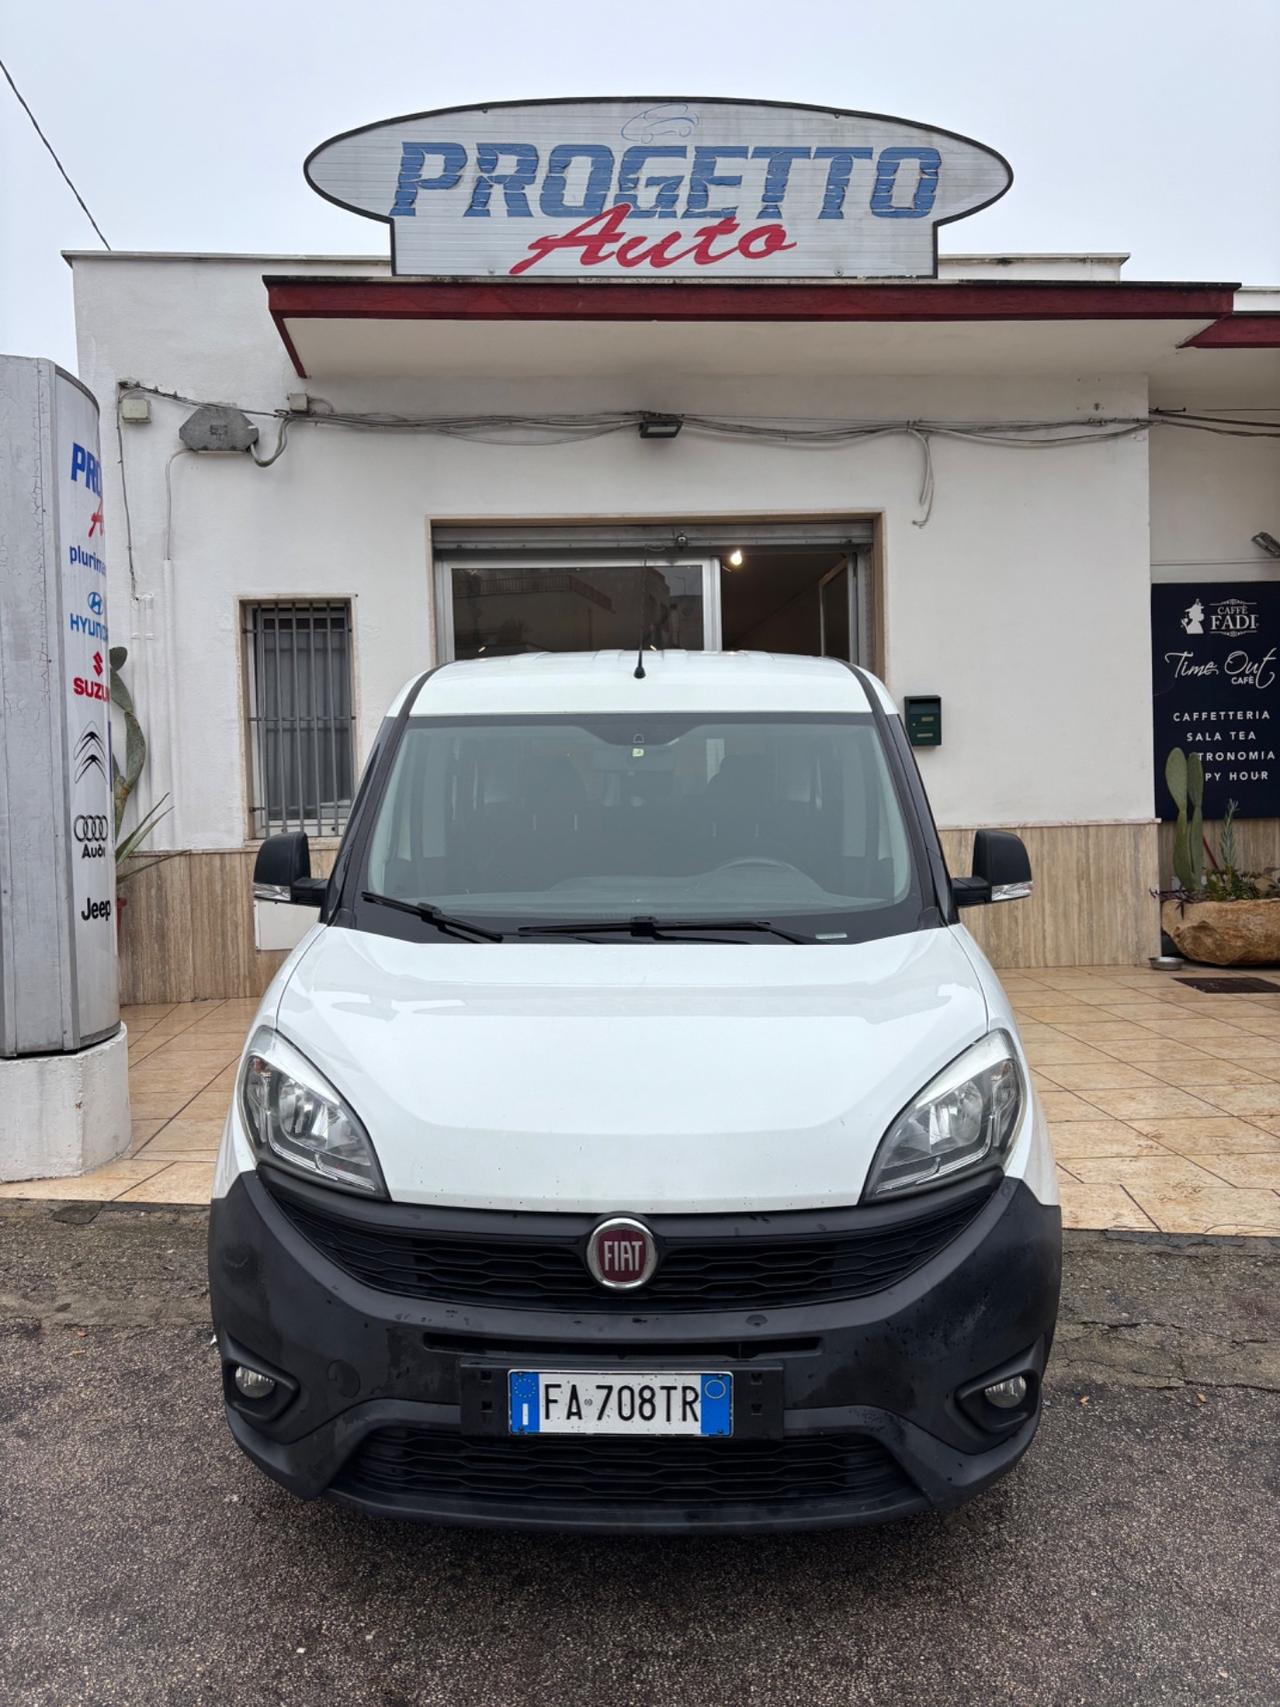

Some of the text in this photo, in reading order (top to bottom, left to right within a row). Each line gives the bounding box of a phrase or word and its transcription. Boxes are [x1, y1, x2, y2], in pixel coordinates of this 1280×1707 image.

[389, 141, 942, 219] PROGETTO
[510, 202, 798, 275] Auto
[71, 442, 103, 497] PRO
[70, 613, 108, 643] HYUND
[1210, 614, 1258, 630] FADI
[1164, 647, 1277, 689] Time Out
[73, 677, 110, 703] SUZU
[1173, 711, 1270, 722] CAFFETTERIA
[1186, 731, 1256, 742] SALA TEA
[1197, 751, 1275, 762] TRONOMIA
[1229, 771, 1268, 781] HOUR
[82, 844, 106, 858] Audi
[81, 897, 111, 921] Jeep
[603, 1240, 643, 1272] FIAT
